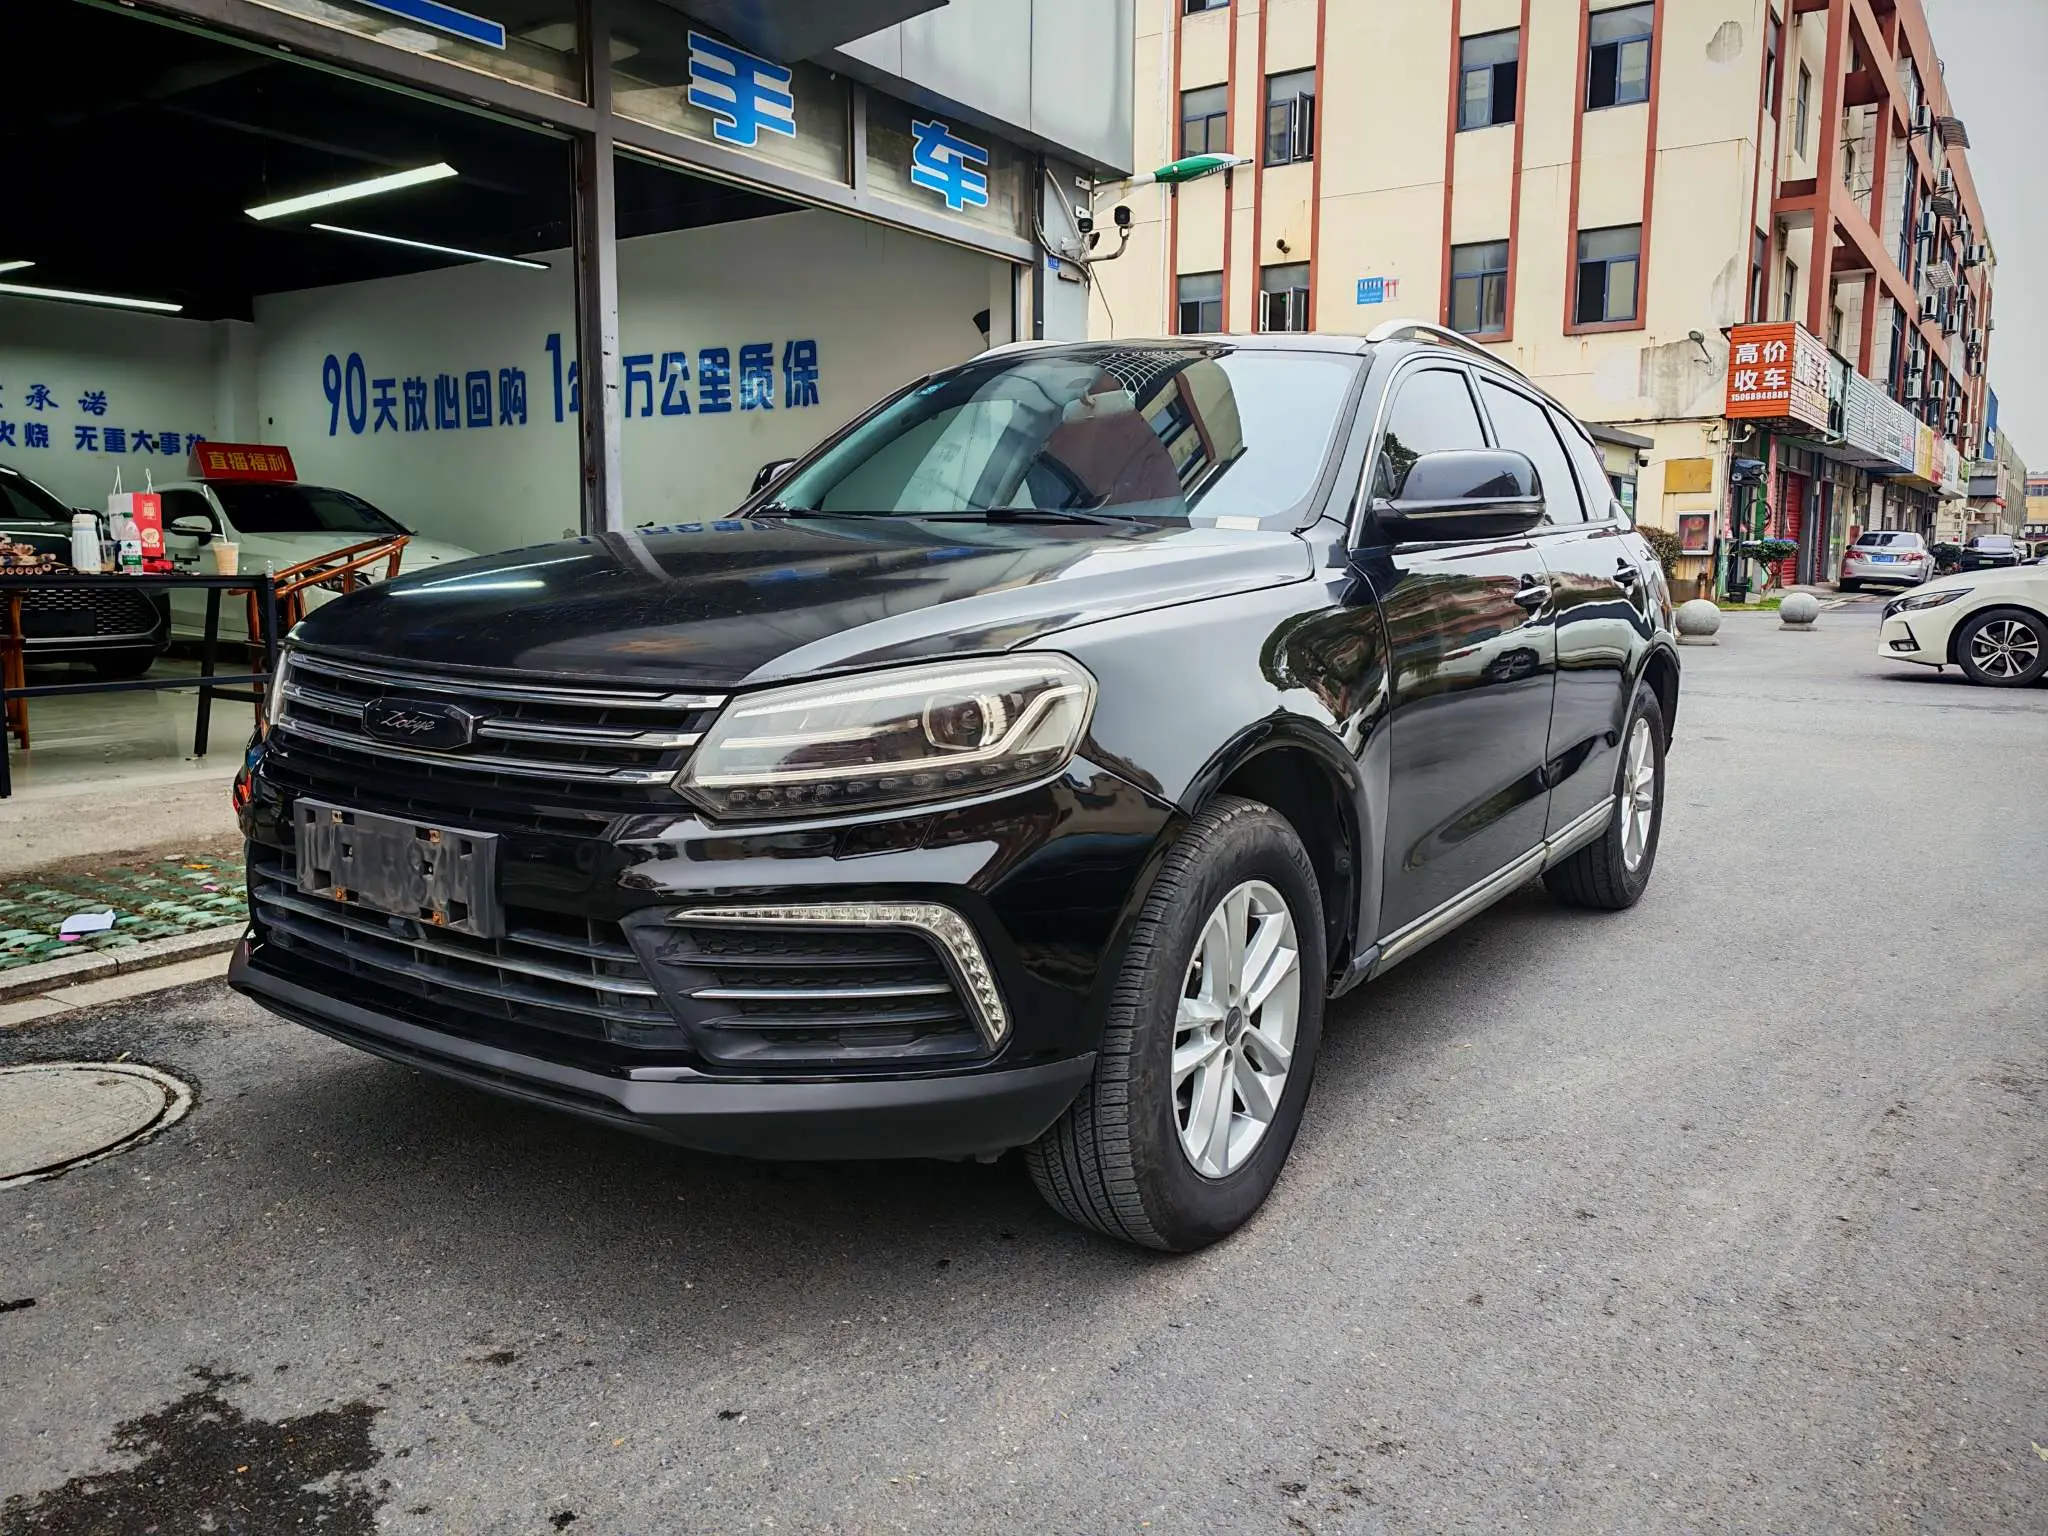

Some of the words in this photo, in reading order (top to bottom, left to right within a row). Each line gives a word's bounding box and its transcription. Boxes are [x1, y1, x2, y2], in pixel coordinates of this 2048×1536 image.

[1735, 340, 1788, 365] 高价
[622, 339, 820, 418] 万公里质保
[1734, 367, 1787, 391] 收车
[0, 383, 108, 416] 承诺
[322, 352, 527, 437] 90天放心回购
[206, 451, 287, 472] 直播福利
[380, 710, 435, 735] Zotye
